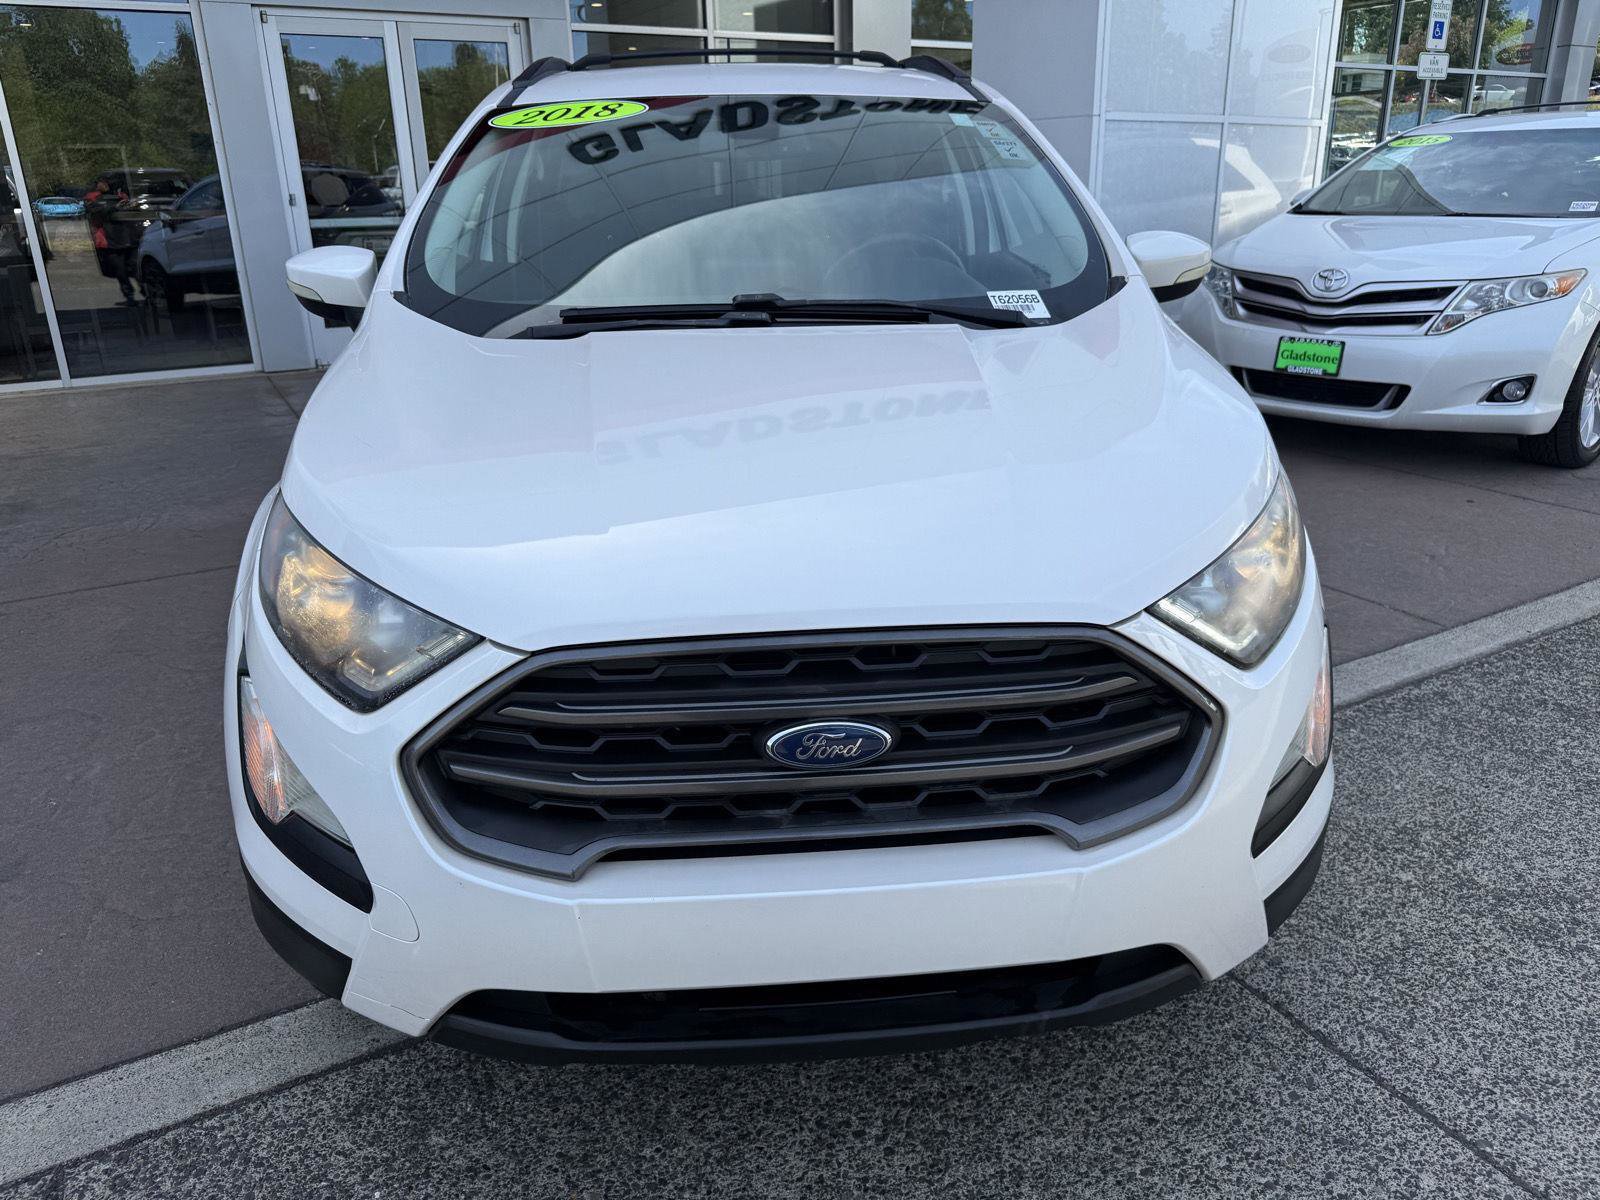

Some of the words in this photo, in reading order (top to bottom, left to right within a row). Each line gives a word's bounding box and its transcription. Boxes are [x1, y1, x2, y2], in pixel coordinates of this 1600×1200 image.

[513, 103, 623, 125] 2018
[990, 294, 1040, 305] T62056B
[1281, 349, 1338, 365] Gladstone
[1287, 365, 1323, 375] GLADSTONE
[796, 732, 862, 760] Ford
